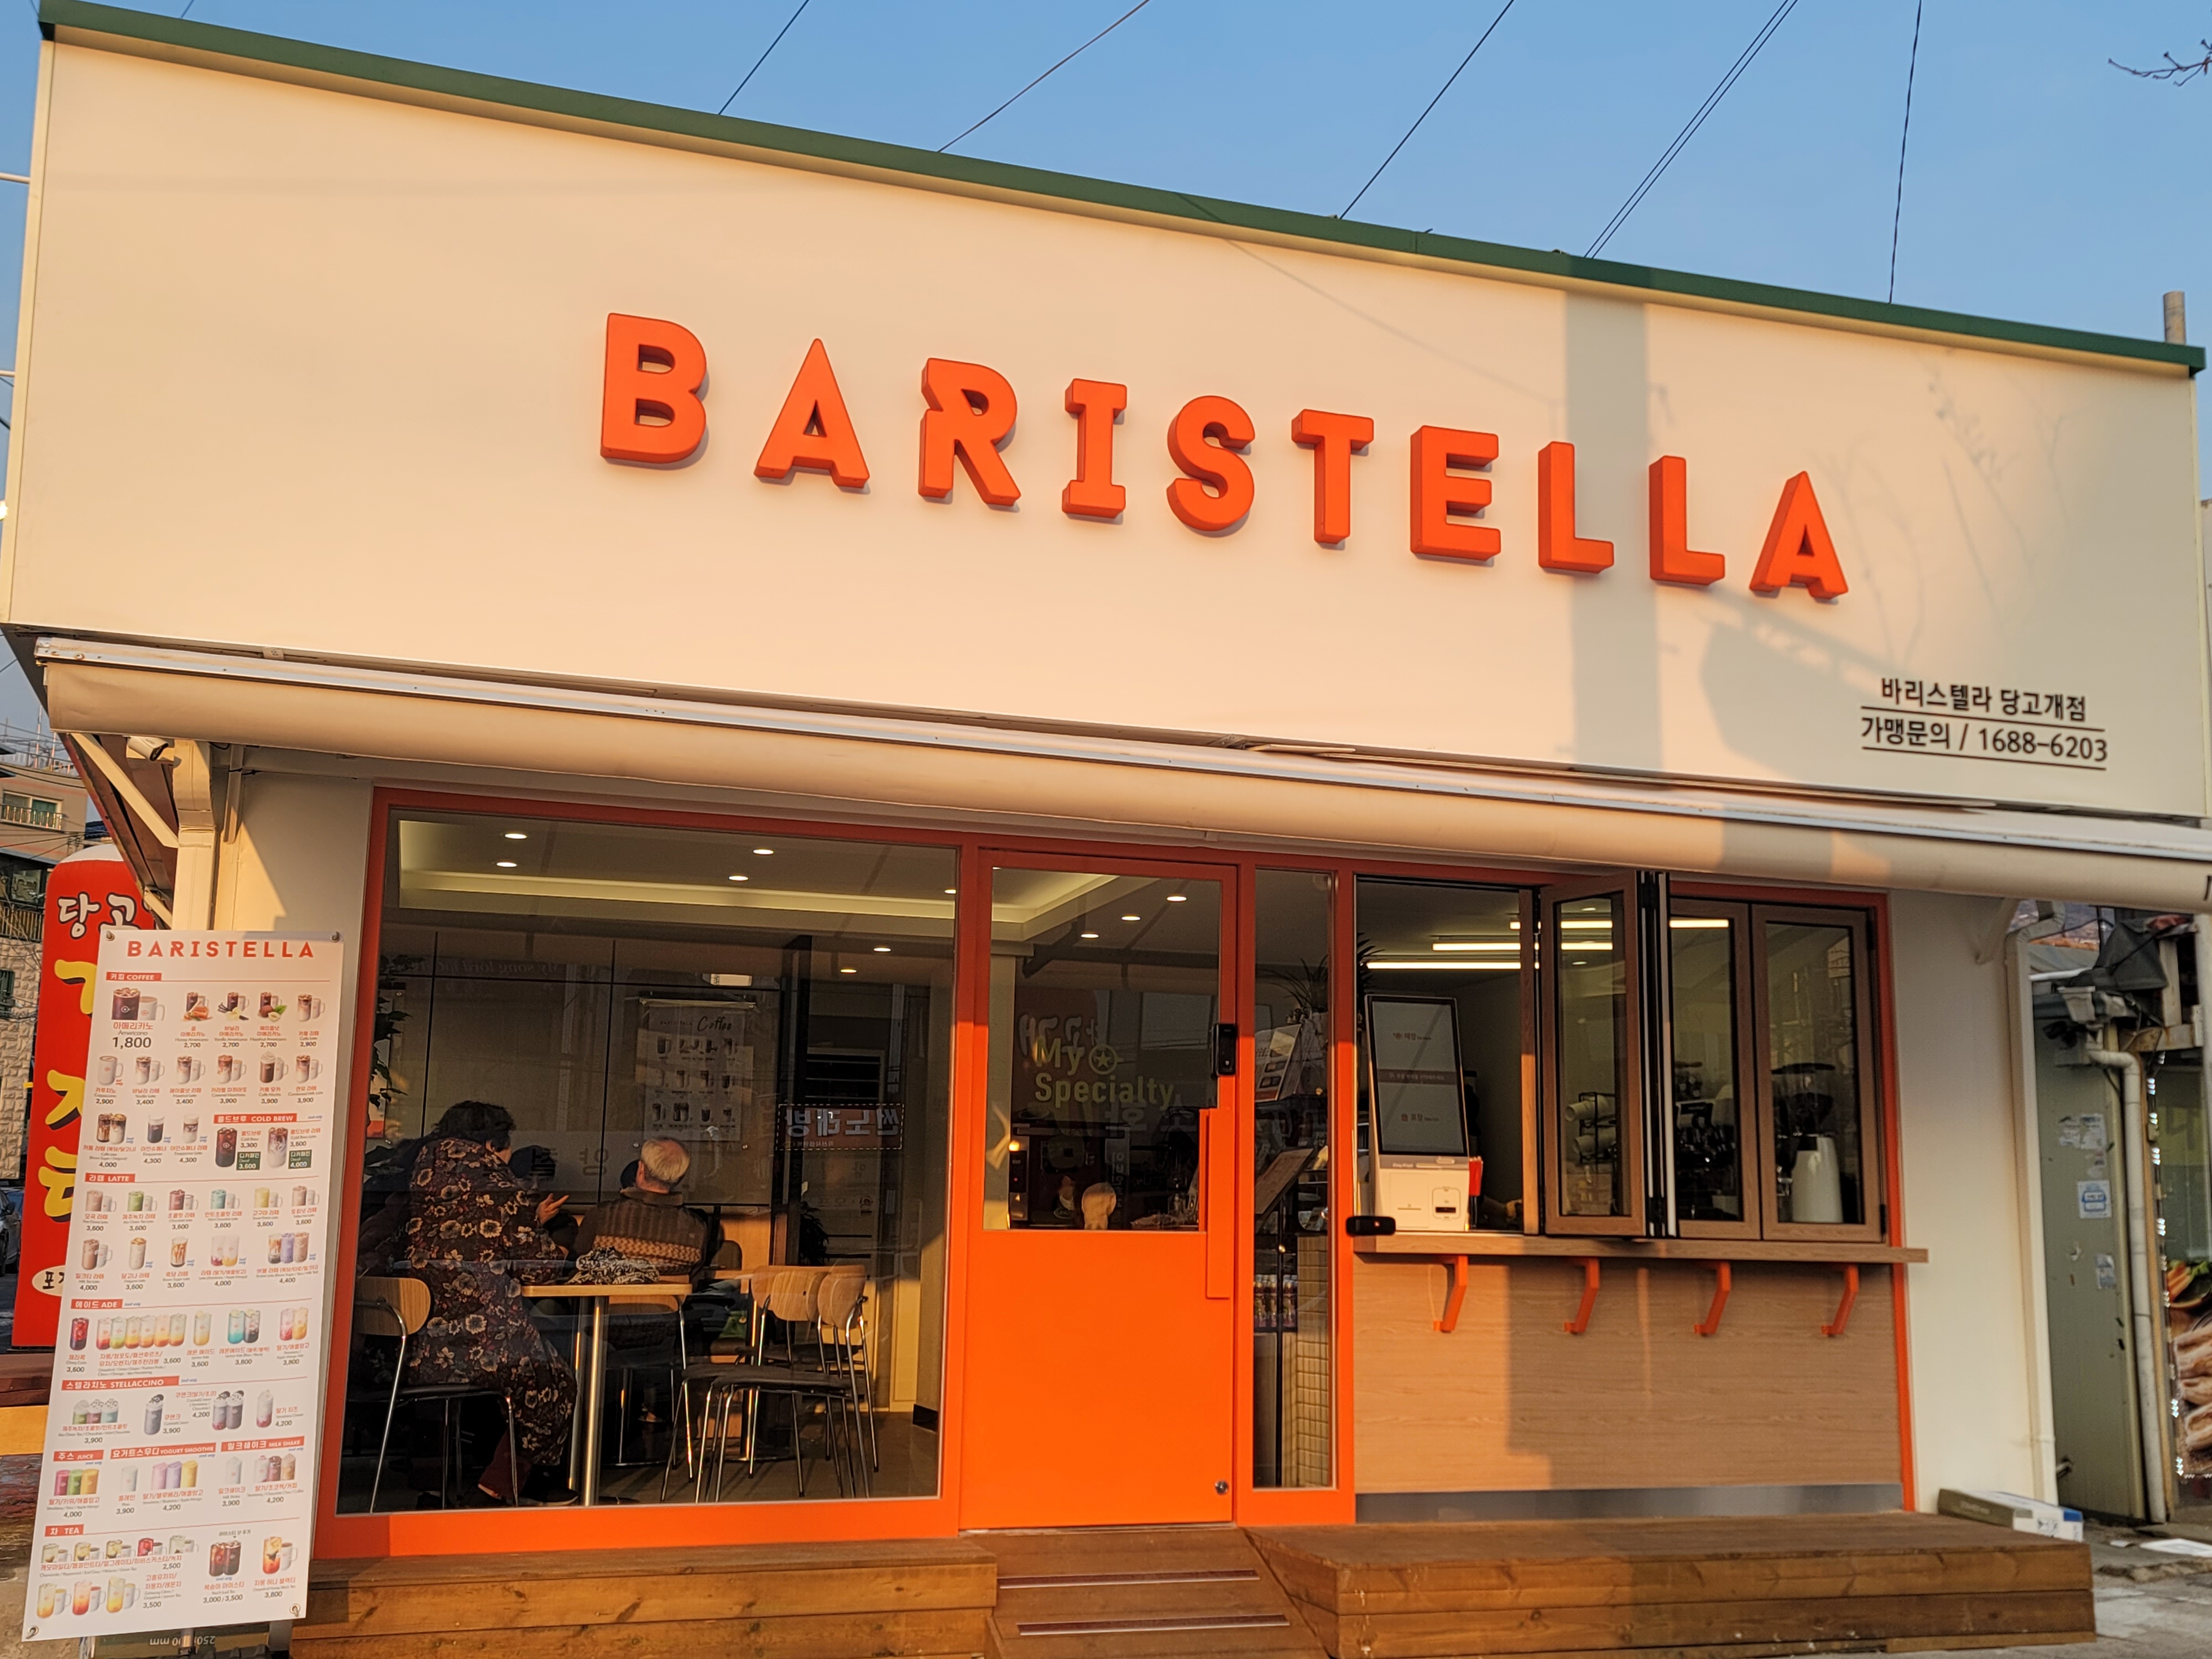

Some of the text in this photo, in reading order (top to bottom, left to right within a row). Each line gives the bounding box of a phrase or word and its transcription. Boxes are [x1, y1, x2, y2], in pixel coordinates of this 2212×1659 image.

[601, 313, 1849, 601] BARISTELLA
[1882, 678, 2085, 720] 바리스텔라 당고개점
[1862, 717, 2107, 761] 가맹문의 / 1688-6203
[58, 892, 142, 938] 당고
[127, 941, 314, 958] BARISTELLA
[113, 1037, 152, 1049] 1,800
[1035, 1037, 1083, 1075] My
[1035, 1073, 1174, 1112] Specialty
[66, 1379, 164, 1389] 스텔라치노 STELLACCINO
[112, 1448, 159, 1458] 요거트스무디
